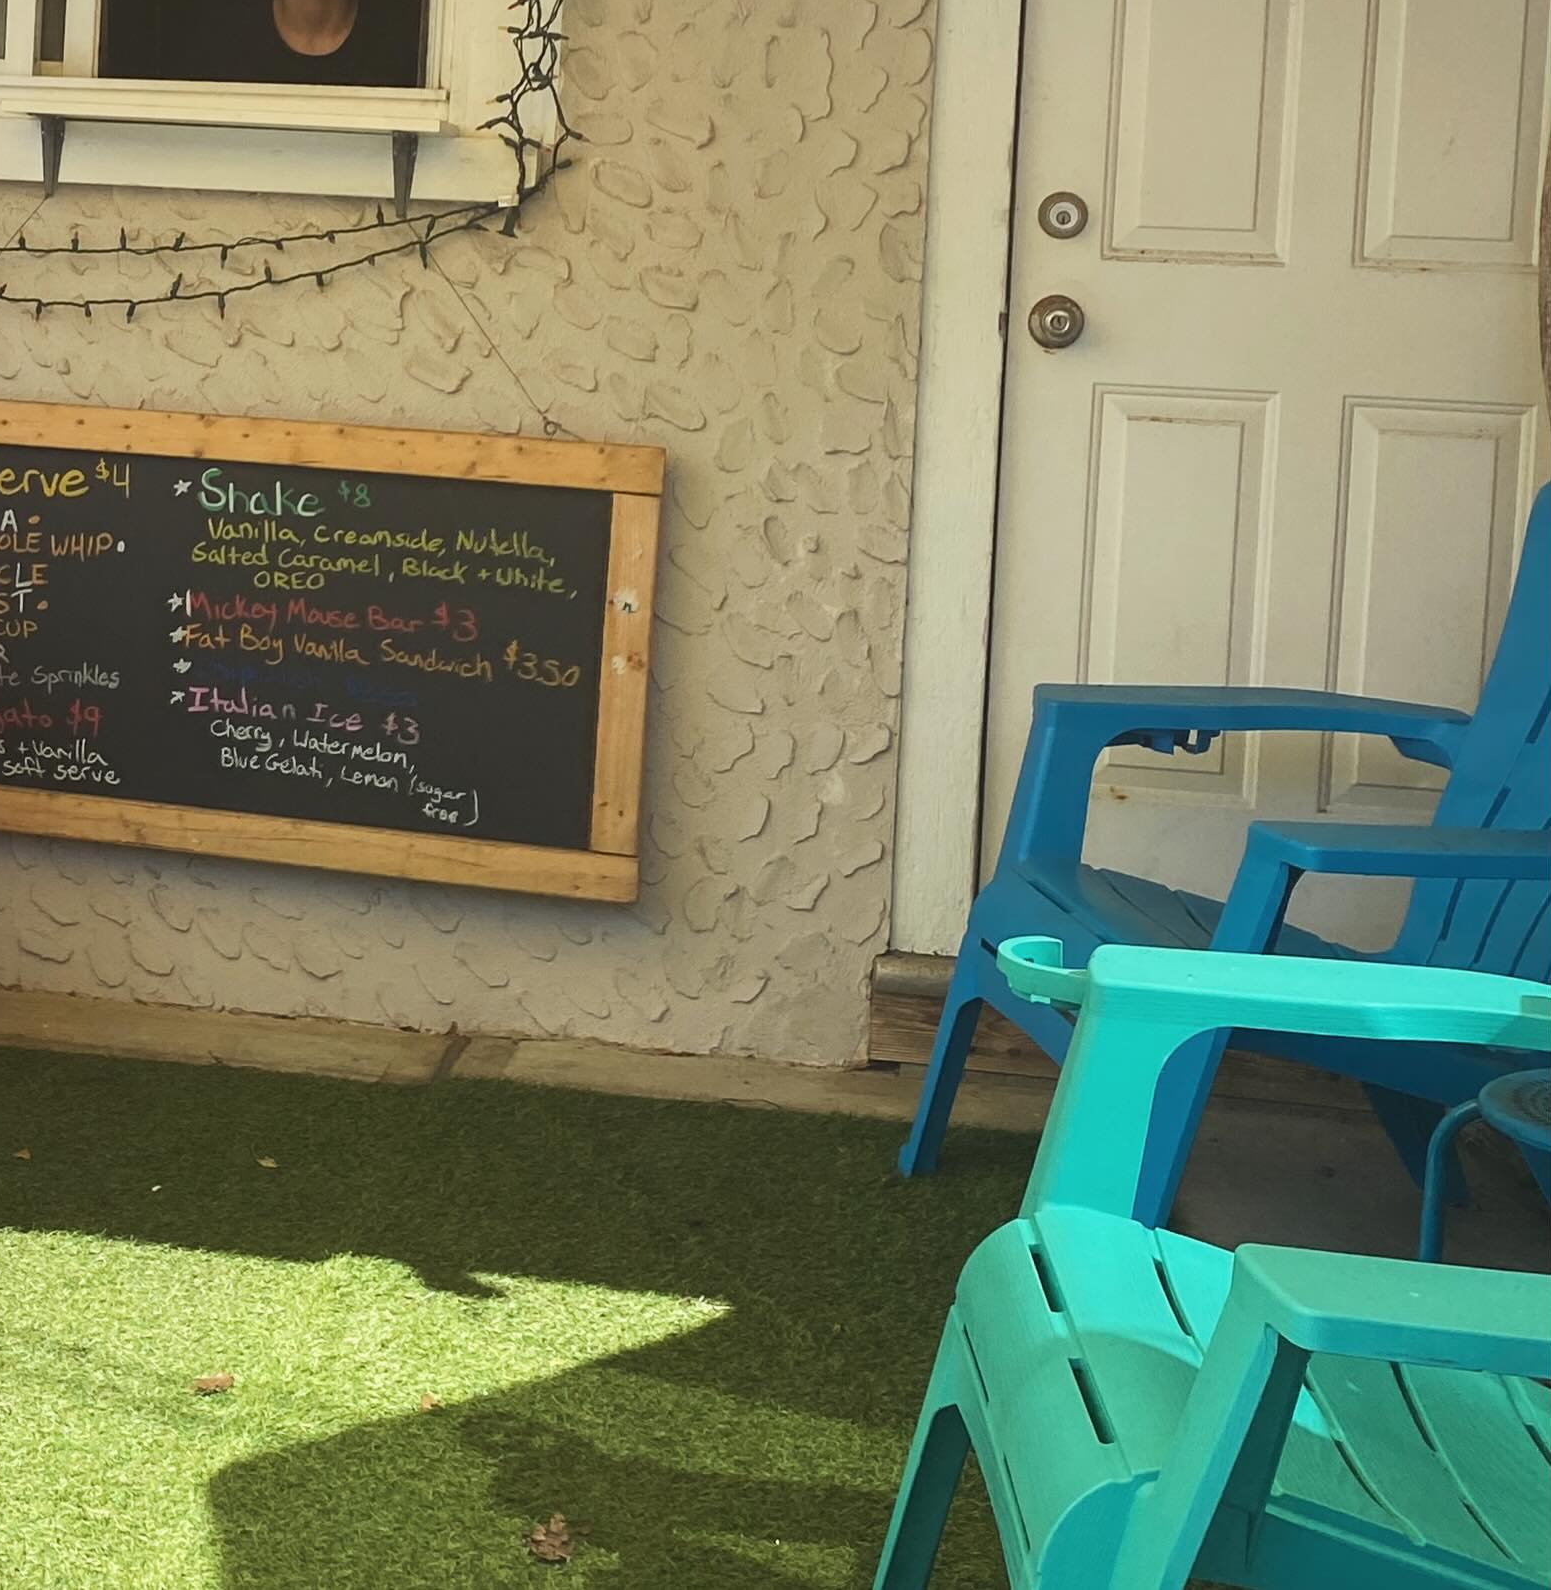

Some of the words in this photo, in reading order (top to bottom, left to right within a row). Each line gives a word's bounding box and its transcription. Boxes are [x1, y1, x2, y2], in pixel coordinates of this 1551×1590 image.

[95, 457, 132, 499] $4
[197, 467, 326, 517] Shake
[337, 480, 372, 508] $8
[51, 532, 115, 562] WHIP
[191, 541, 269, 566] Salted
[402, 556, 469, 584] Black
[253, 570, 326, 590] OREO
[287, 597, 361, 629] Mouse
[368, 605, 424, 633] Bar
[432, 601, 480, 642] $3
[184, 624, 231, 649] Fat
[239, 625, 283, 665] Boy
[293, 633, 370, 666] Vanilla
[380, 639, 494, 682] Sandwich
[66, 697, 104, 736] $9
[188, 686, 296, 720] Italian
[306, 703, 364, 731] Ice
[382, 712, 420, 745] $3
[32, 738, 108, 766] Vanilla
[221, 748, 260, 769] Blue
[341, 765, 398, 793] Lemon
